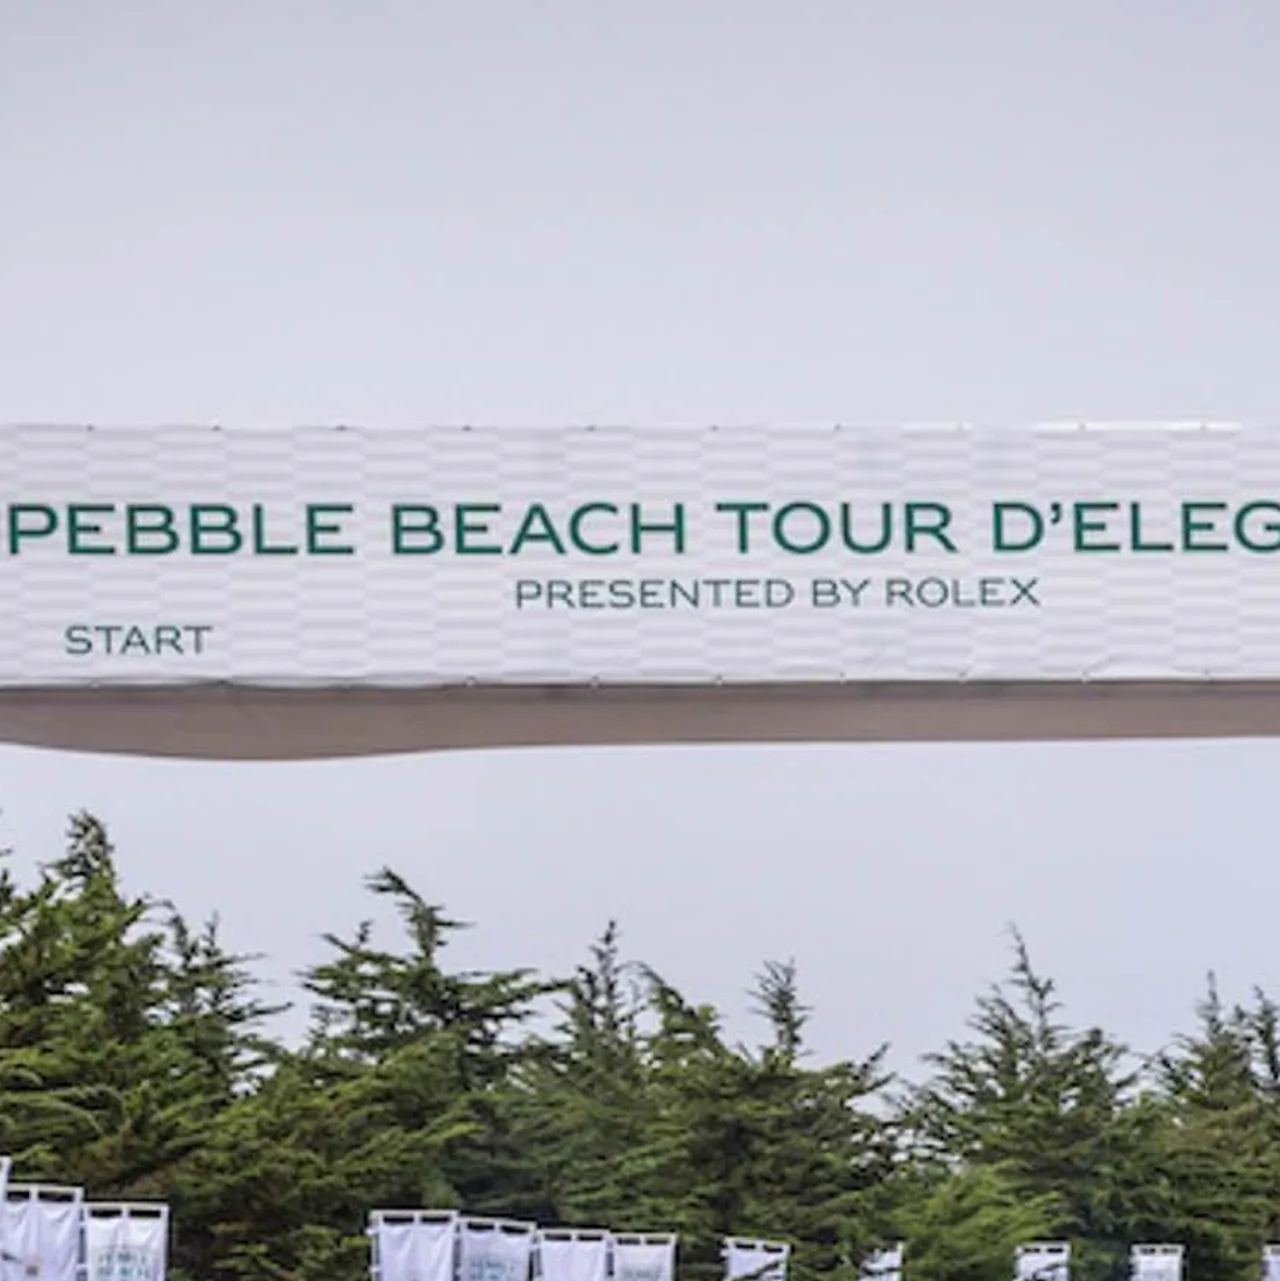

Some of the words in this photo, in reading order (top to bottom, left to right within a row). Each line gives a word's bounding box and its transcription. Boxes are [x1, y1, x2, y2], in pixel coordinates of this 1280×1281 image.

[7, 503, 355, 556] PEBBLE
[391, 502, 685, 556] BEACH
[715, 501, 957, 555] TOUR
[515, 578, 795, 609] PRESENTED
[811, 578, 871, 608] BY
[885, 576, 1040, 608] ROLEX
[65, 624, 213, 655] START
